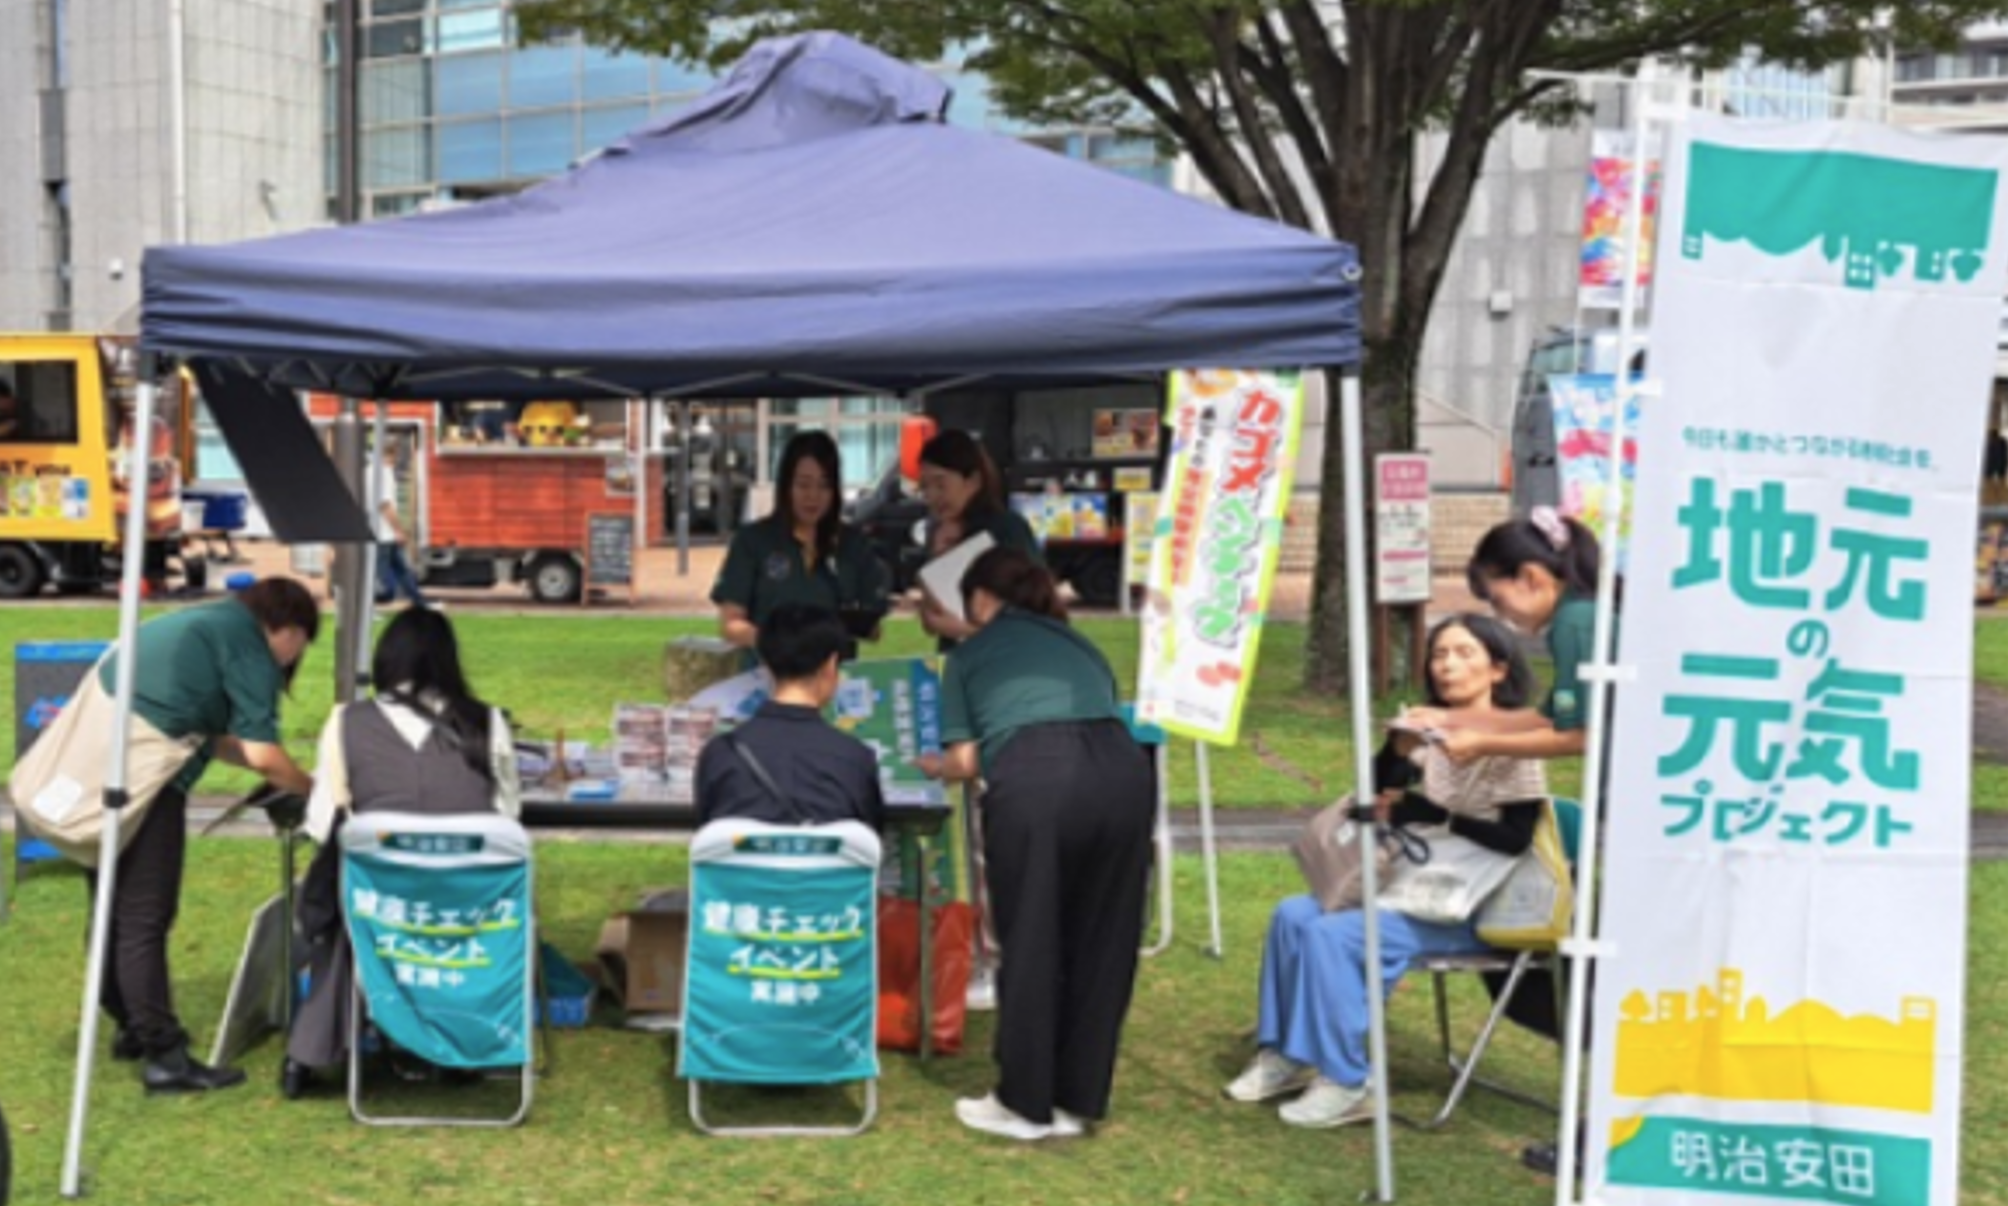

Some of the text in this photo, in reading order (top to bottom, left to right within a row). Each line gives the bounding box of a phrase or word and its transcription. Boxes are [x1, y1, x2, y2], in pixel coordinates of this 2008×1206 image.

[1672, 477, 1930, 622] 地元
[1787, 619, 1830, 657] の
[1657, 652, 1921, 791] 元気
[1659, 780, 1915, 848] プロジェクト
[376, 934, 486, 962] イベント
[729, 944, 839, 974] イベント
[1669, 1129, 1877, 1197] 明治安田
